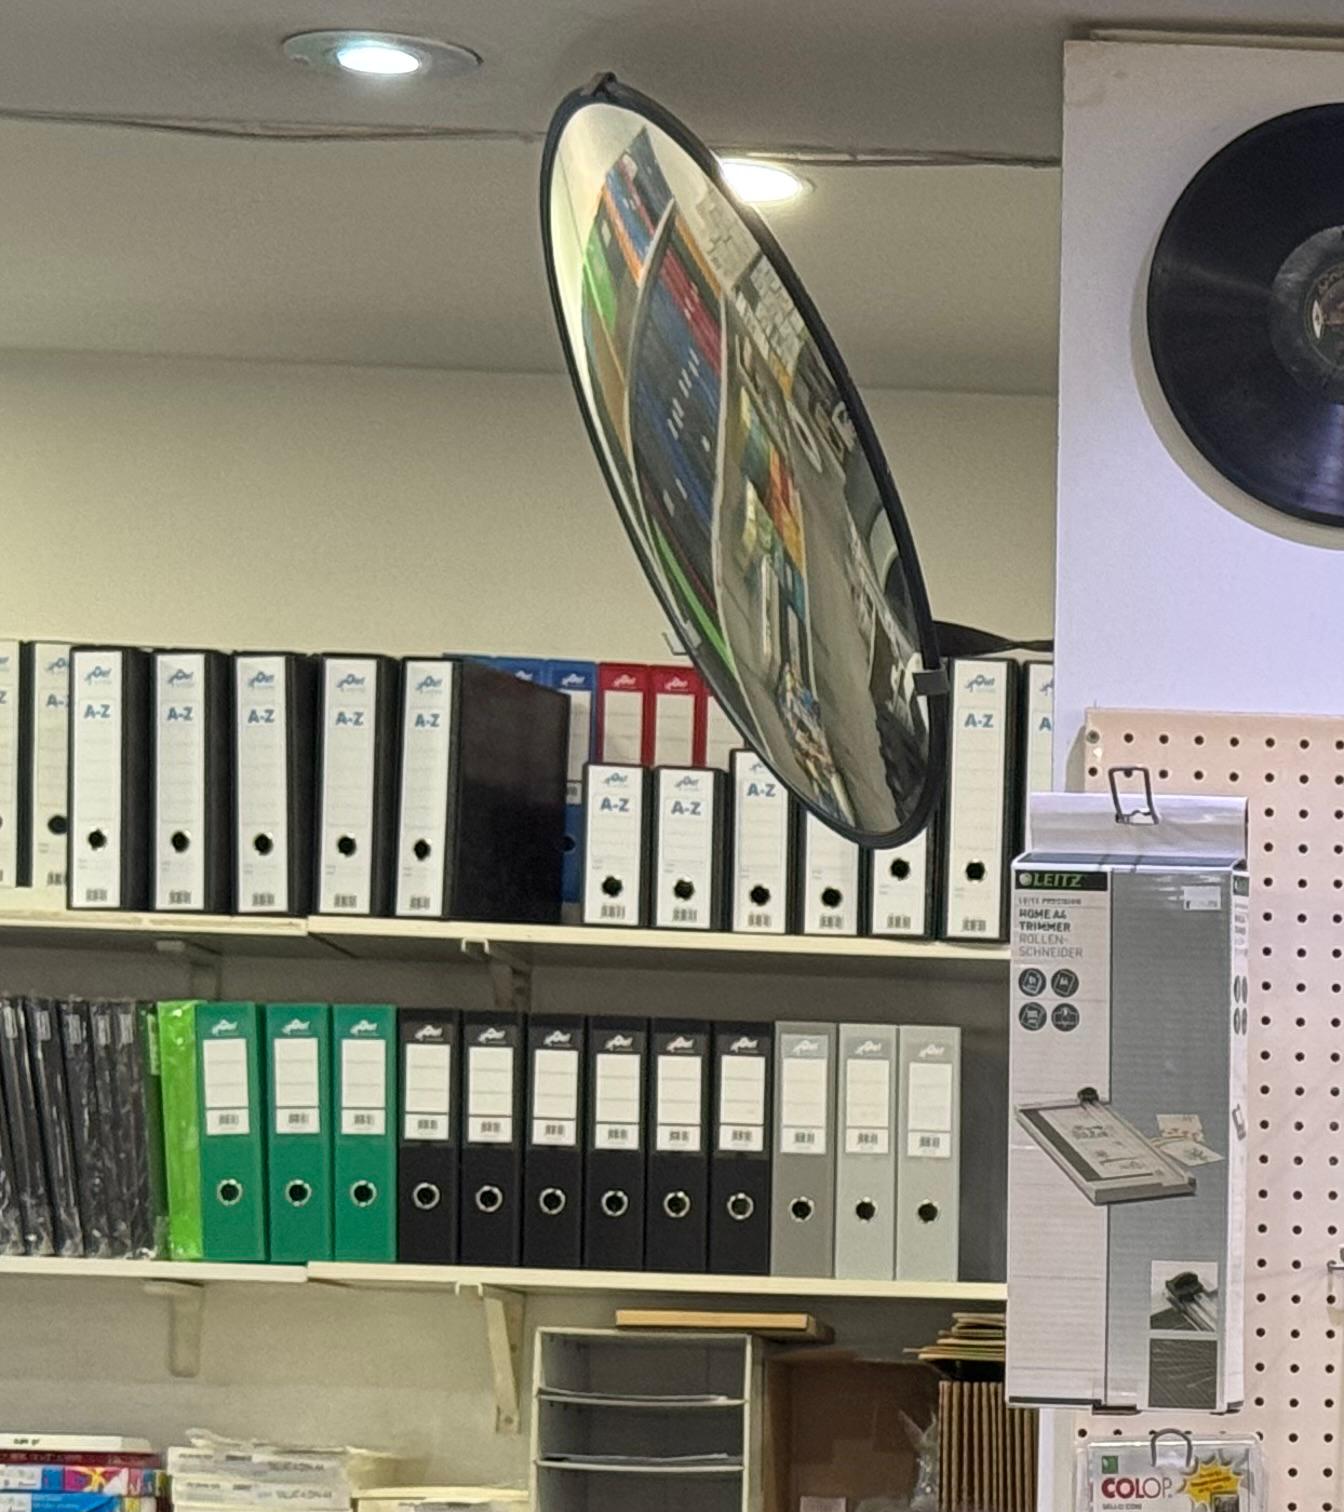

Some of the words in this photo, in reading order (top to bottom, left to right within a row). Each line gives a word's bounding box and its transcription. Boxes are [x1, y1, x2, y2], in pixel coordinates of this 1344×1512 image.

[84, 704, 111, 719] A-Z
[167, 706, 193, 721] A-Z
[248, 709, 275, 724] A-Z
[335, 711, 363, 726] A-Z
[414, 712, 440, 728] A-Z
[964, 712, 994, 730] A-Z
[747, 783, 776, 798] A-Z
[600, 797, 630, 814] A-Z
[671, 801, 702, 817] A-Z
[1033, 873, 1082, 887] LEITZ
[1019, 909, 1049, 919] HOME
[1053, 910, 1067, 919] A4
[1019, 921, 1071, 932] TRIMMER
[1019, 933, 1066, 944] ROLLEN-
[1019, 947, 1083, 957] SCHNEIDER
[1101, 1477, 1173, 1499] COLOP
